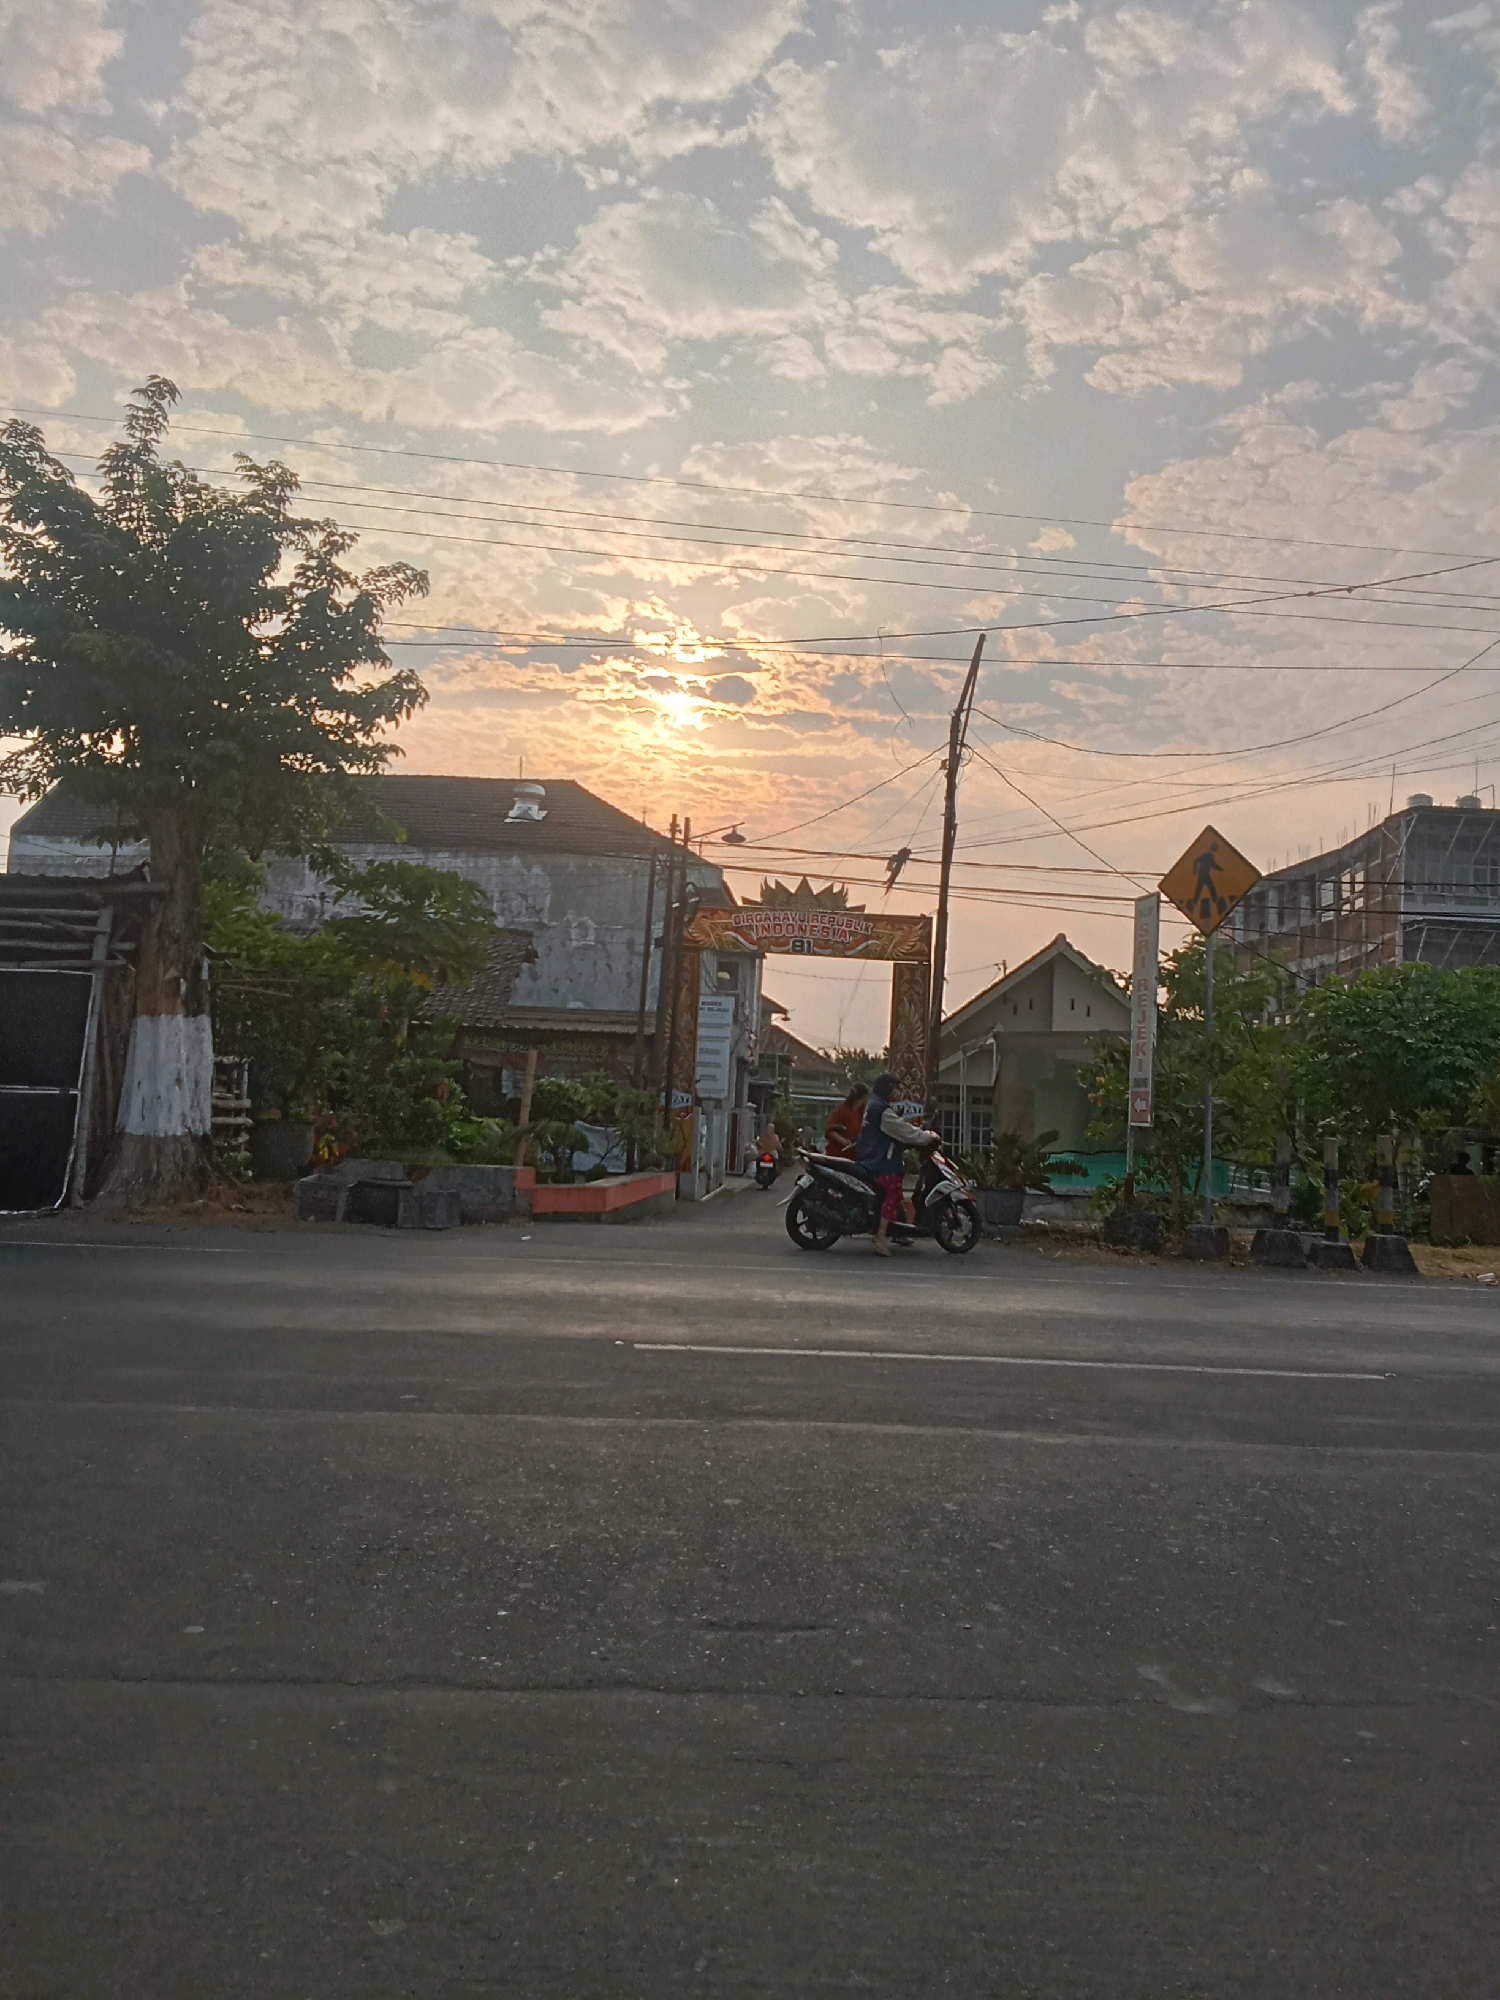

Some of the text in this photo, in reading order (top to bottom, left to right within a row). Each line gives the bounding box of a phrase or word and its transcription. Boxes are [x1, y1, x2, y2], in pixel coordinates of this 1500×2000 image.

[732, 911, 874, 934] DIRGAHAYU REPUBLIK
[754, 922, 849, 942] INDONESIA
[1138, 923, 1150, 969] SRI
[1136, 978, 1149, 1072] REJEKI
